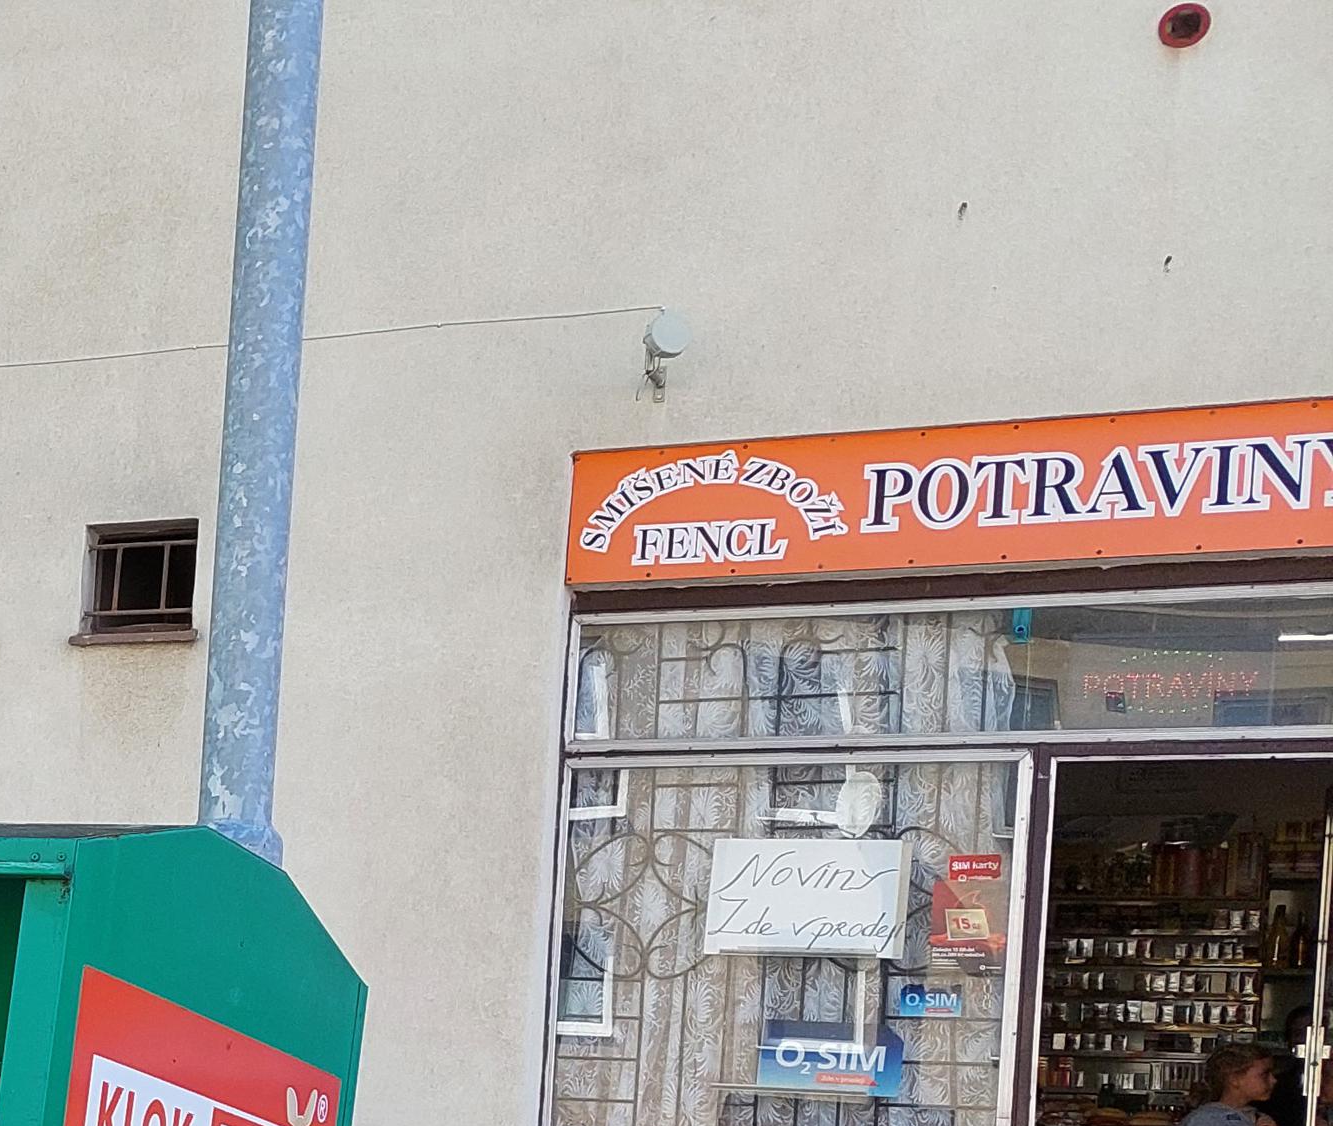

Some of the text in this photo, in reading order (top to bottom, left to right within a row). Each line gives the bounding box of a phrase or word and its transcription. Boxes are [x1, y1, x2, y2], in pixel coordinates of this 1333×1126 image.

[864, 437, 1333, 527] POTRAVIN
[582, 451, 847, 551] SMÍŠENÉ ZBOŽÍ
[634, 521, 785, 562] FENCL
[1084, 670, 1259, 698] POTRAVINY
[712, 850, 899, 891] Noviny
[951, 860, 1000, 872] SIM karty
[708, 896, 780, 936] Zde
[952, 917, 971, 930] 15
[925, 992, 958, 1007] SIM
[817, 1041, 888, 1073] SIM
